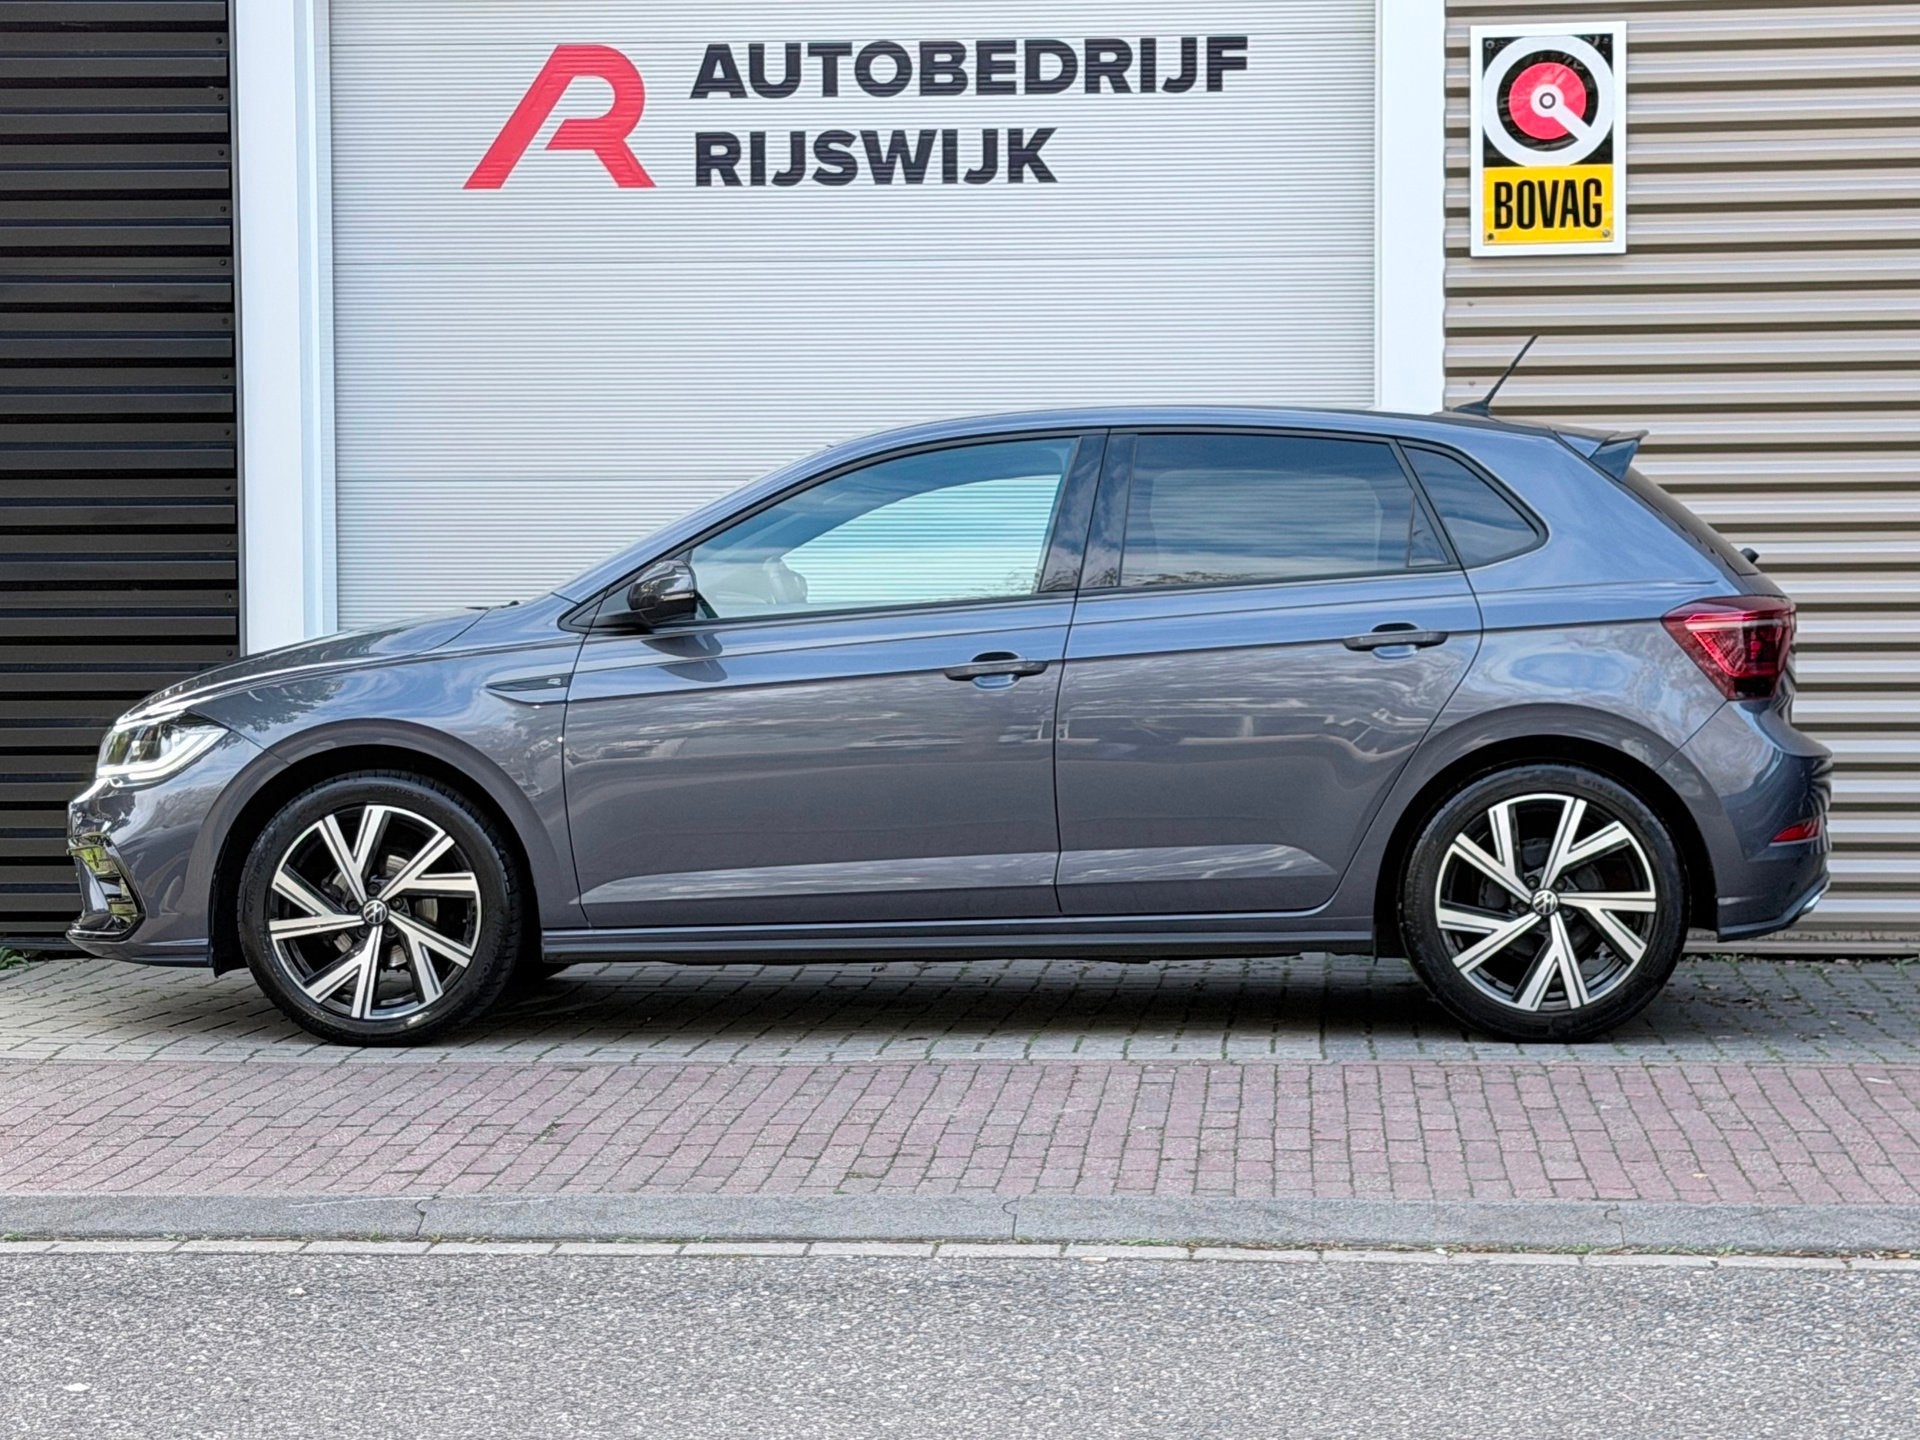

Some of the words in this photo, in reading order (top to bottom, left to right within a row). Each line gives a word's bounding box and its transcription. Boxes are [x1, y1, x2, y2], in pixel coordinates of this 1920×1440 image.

[690, 36, 1248, 99] AUTOBEDRIJF
[695, 127, 1057, 187] RIJSWIJK
[1493, 178, 1602, 230] BOVAG
